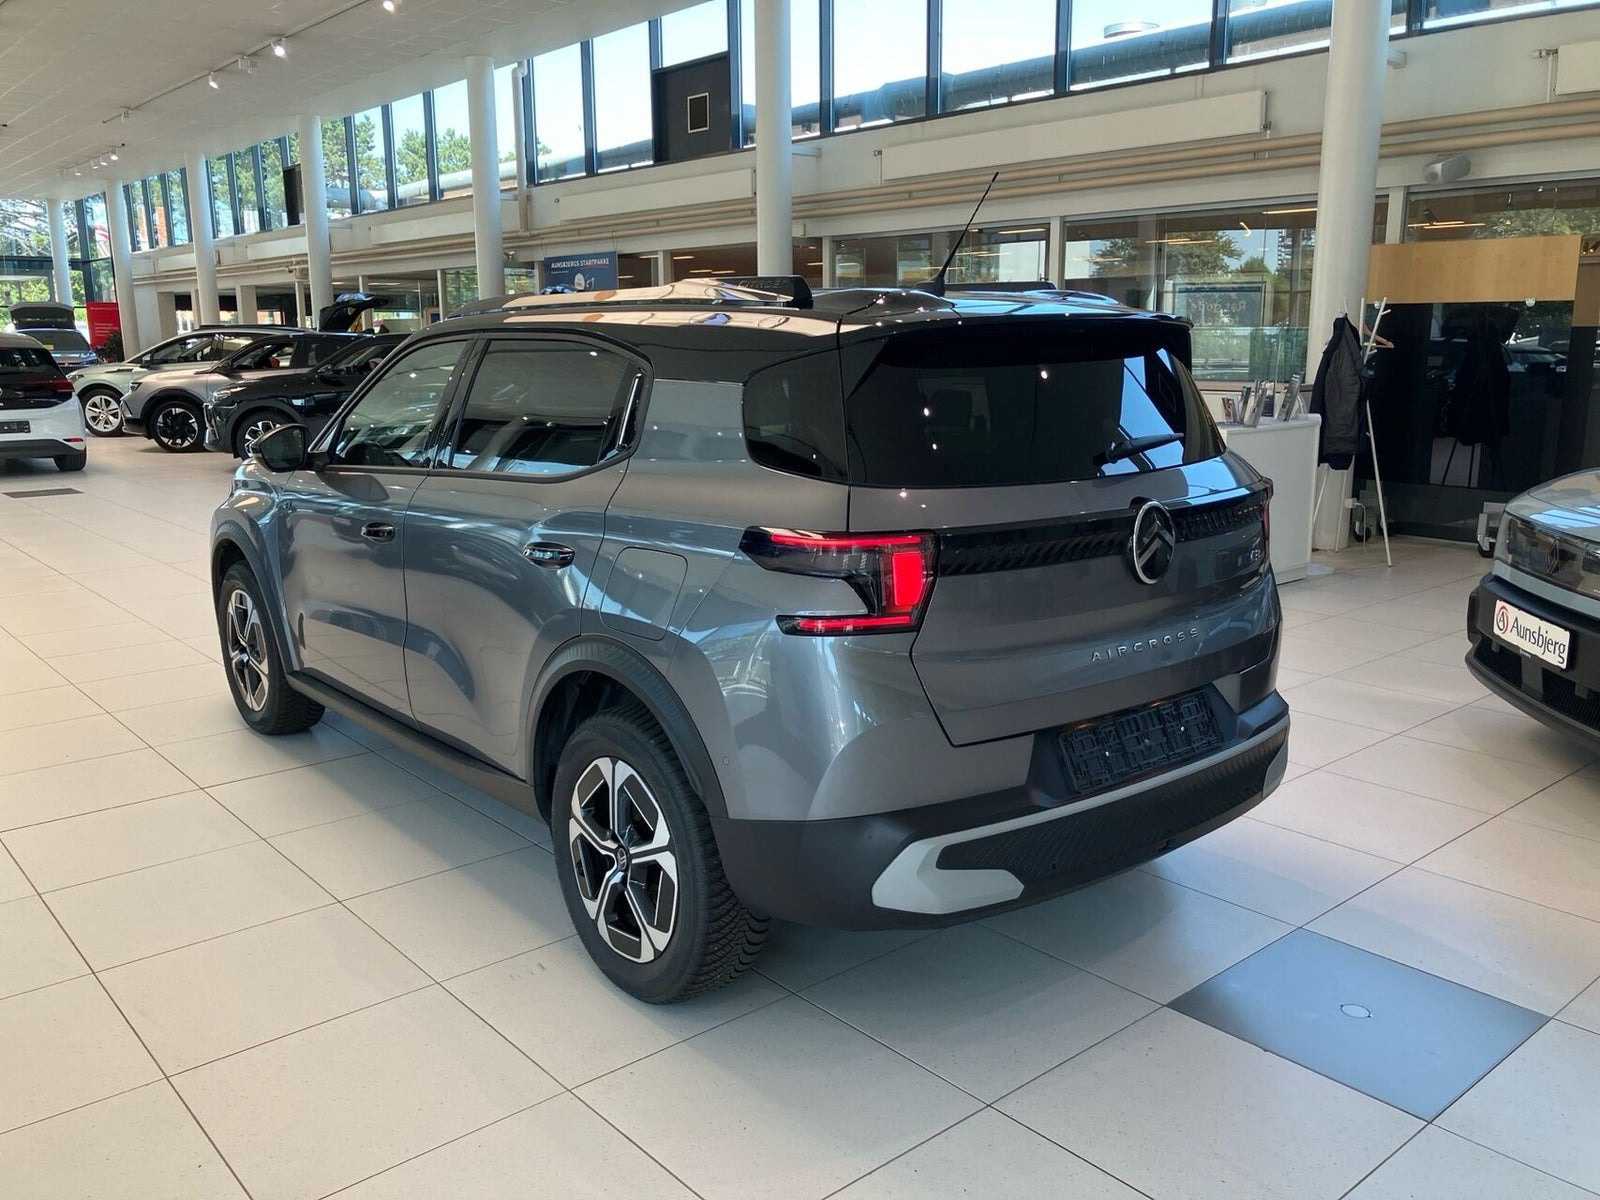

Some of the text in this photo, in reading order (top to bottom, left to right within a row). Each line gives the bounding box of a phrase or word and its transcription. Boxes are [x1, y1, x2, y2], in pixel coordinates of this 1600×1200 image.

[580, 258, 610, 267] STARTPAKKE
[1091, 627, 1200, 662] AIRCROSS
[1510, 617, 1567, 665] Aunsbjerg
